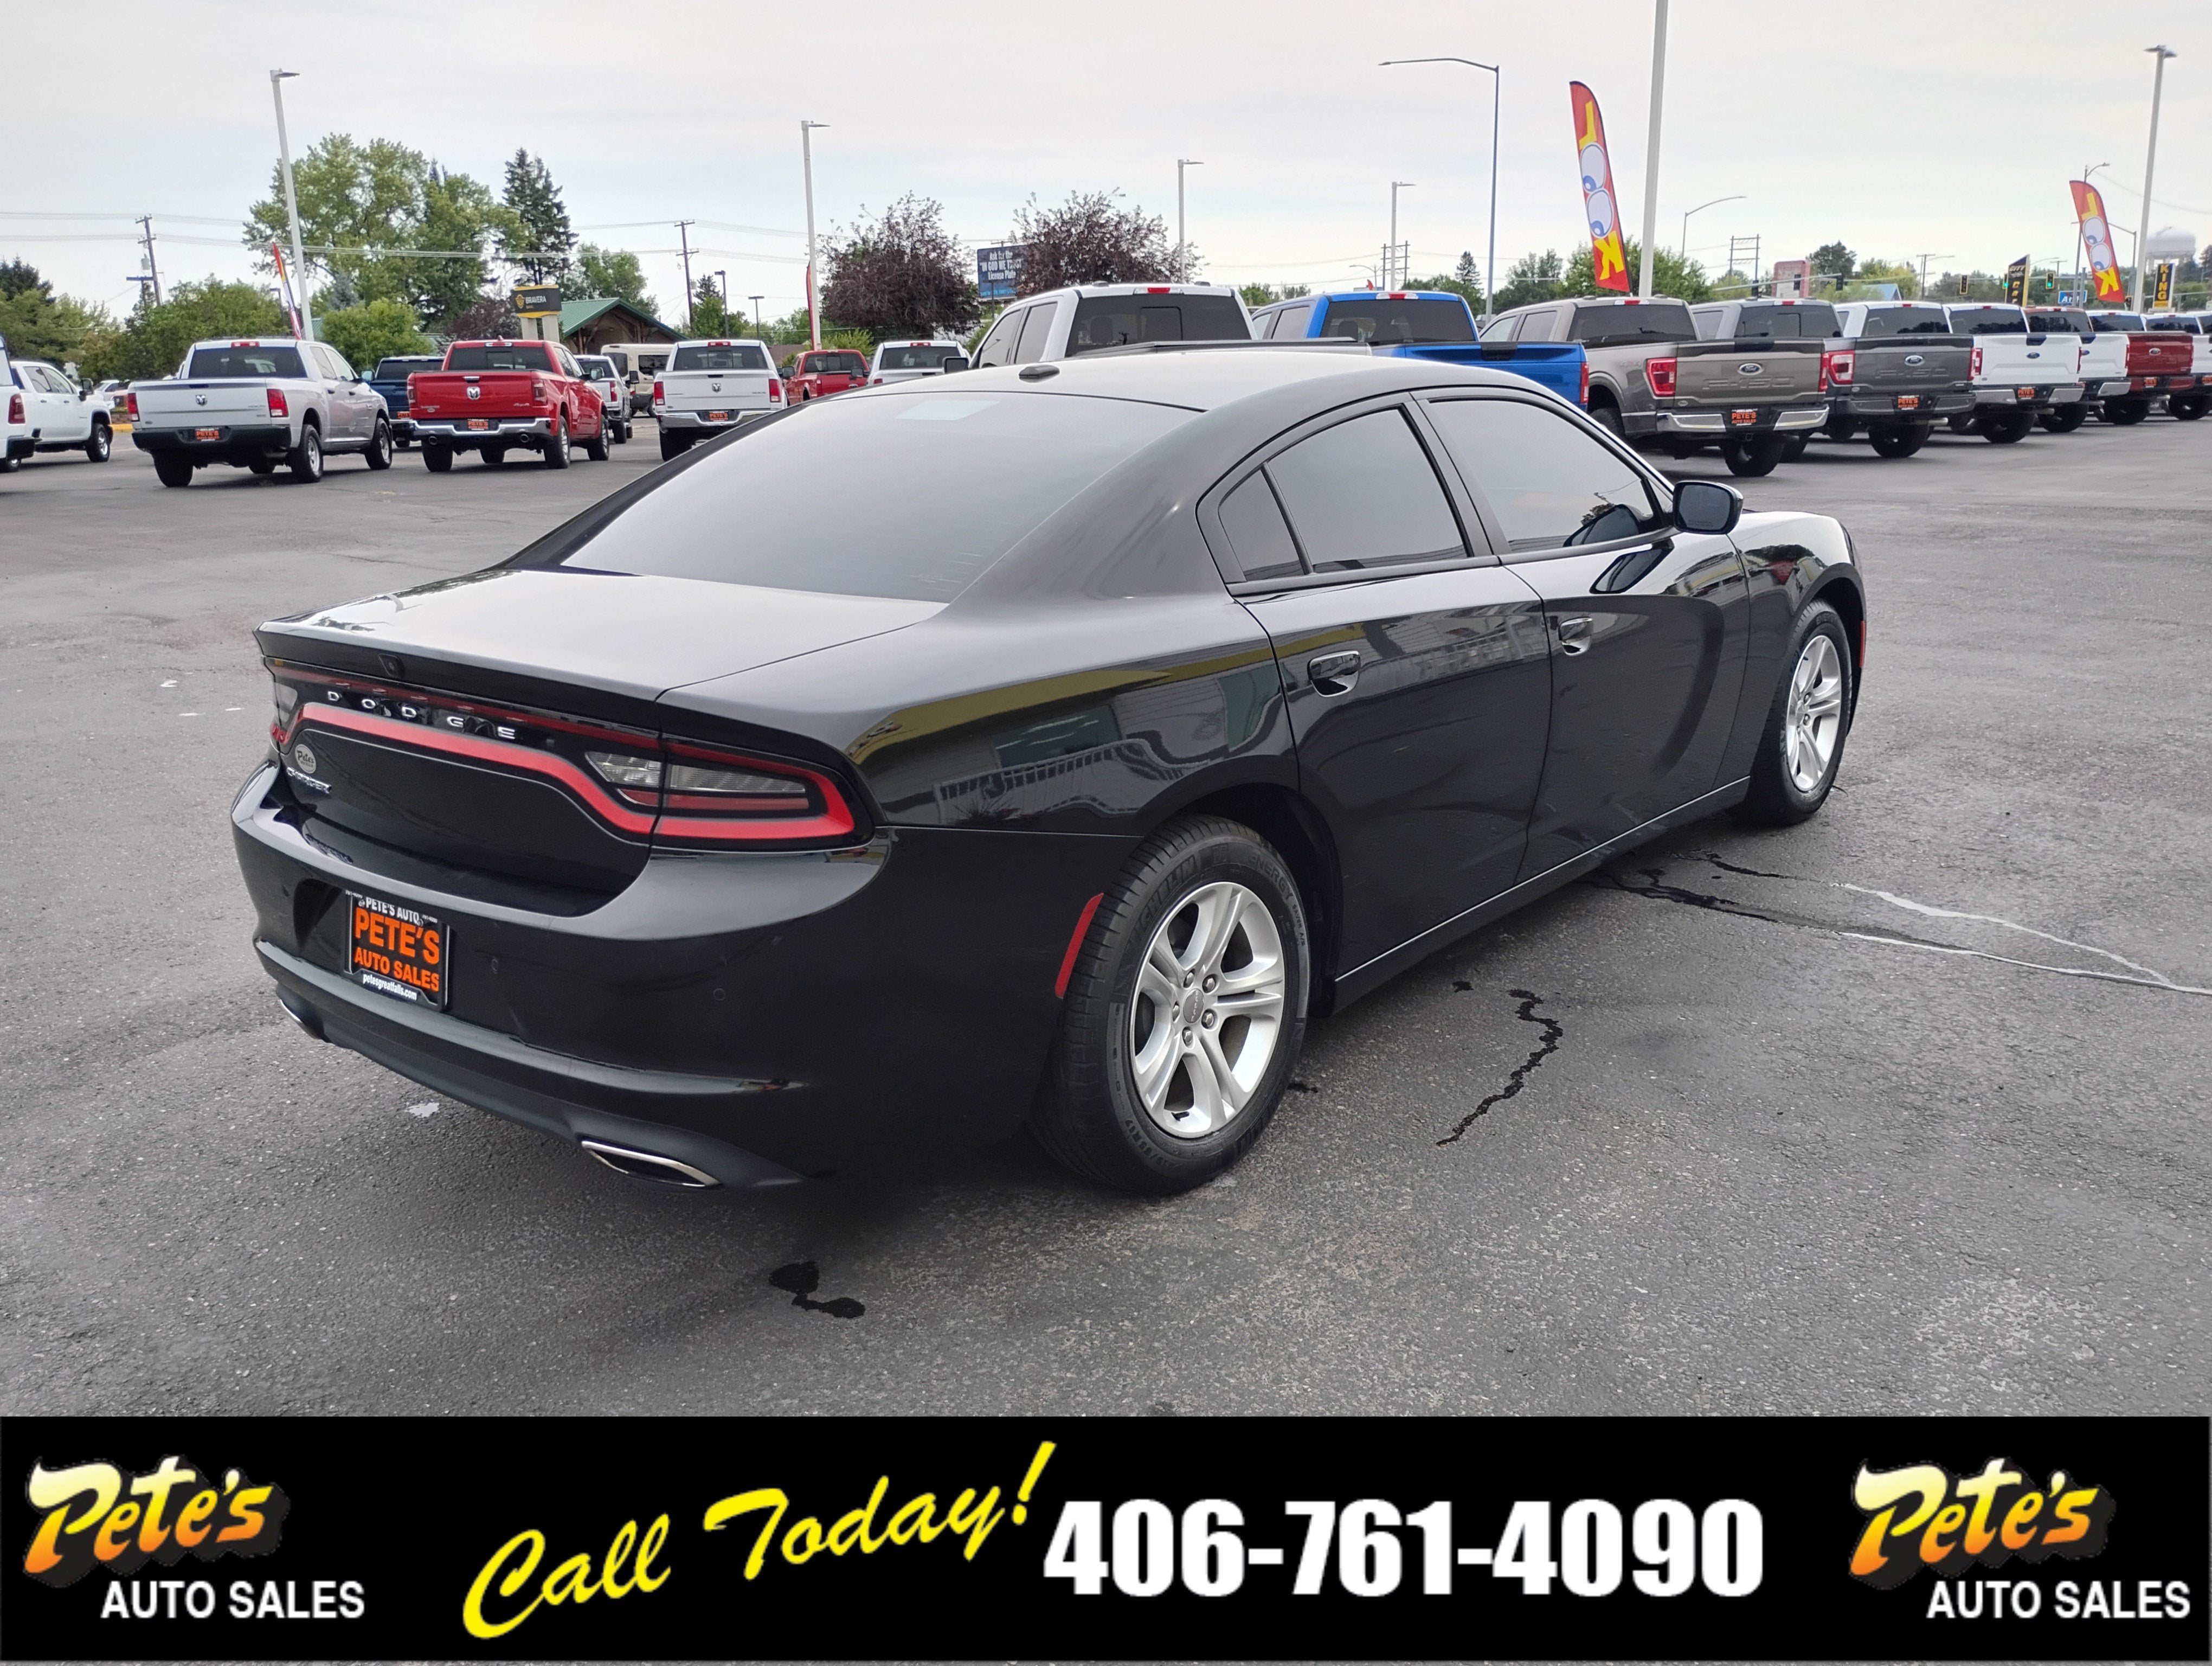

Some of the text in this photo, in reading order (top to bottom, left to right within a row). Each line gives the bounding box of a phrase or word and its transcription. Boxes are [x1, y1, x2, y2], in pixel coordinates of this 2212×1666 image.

[988, 261, 998, 271] GOD
[999, 260, 1006, 270] WE
[989, 251, 998, 260] Ask
[2158, 264, 2169, 300] KING
[525, 296, 546, 304] BRAVERA
[327, 690, 516, 740] DODGE
[366, 896, 420, 925] PETE'S AUTO
[355, 906, 440, 965] PETE'S
[354, 946, 439, 992] AUTO SALES
[363, 973, 417, 1001] petesgreatfalls.com
